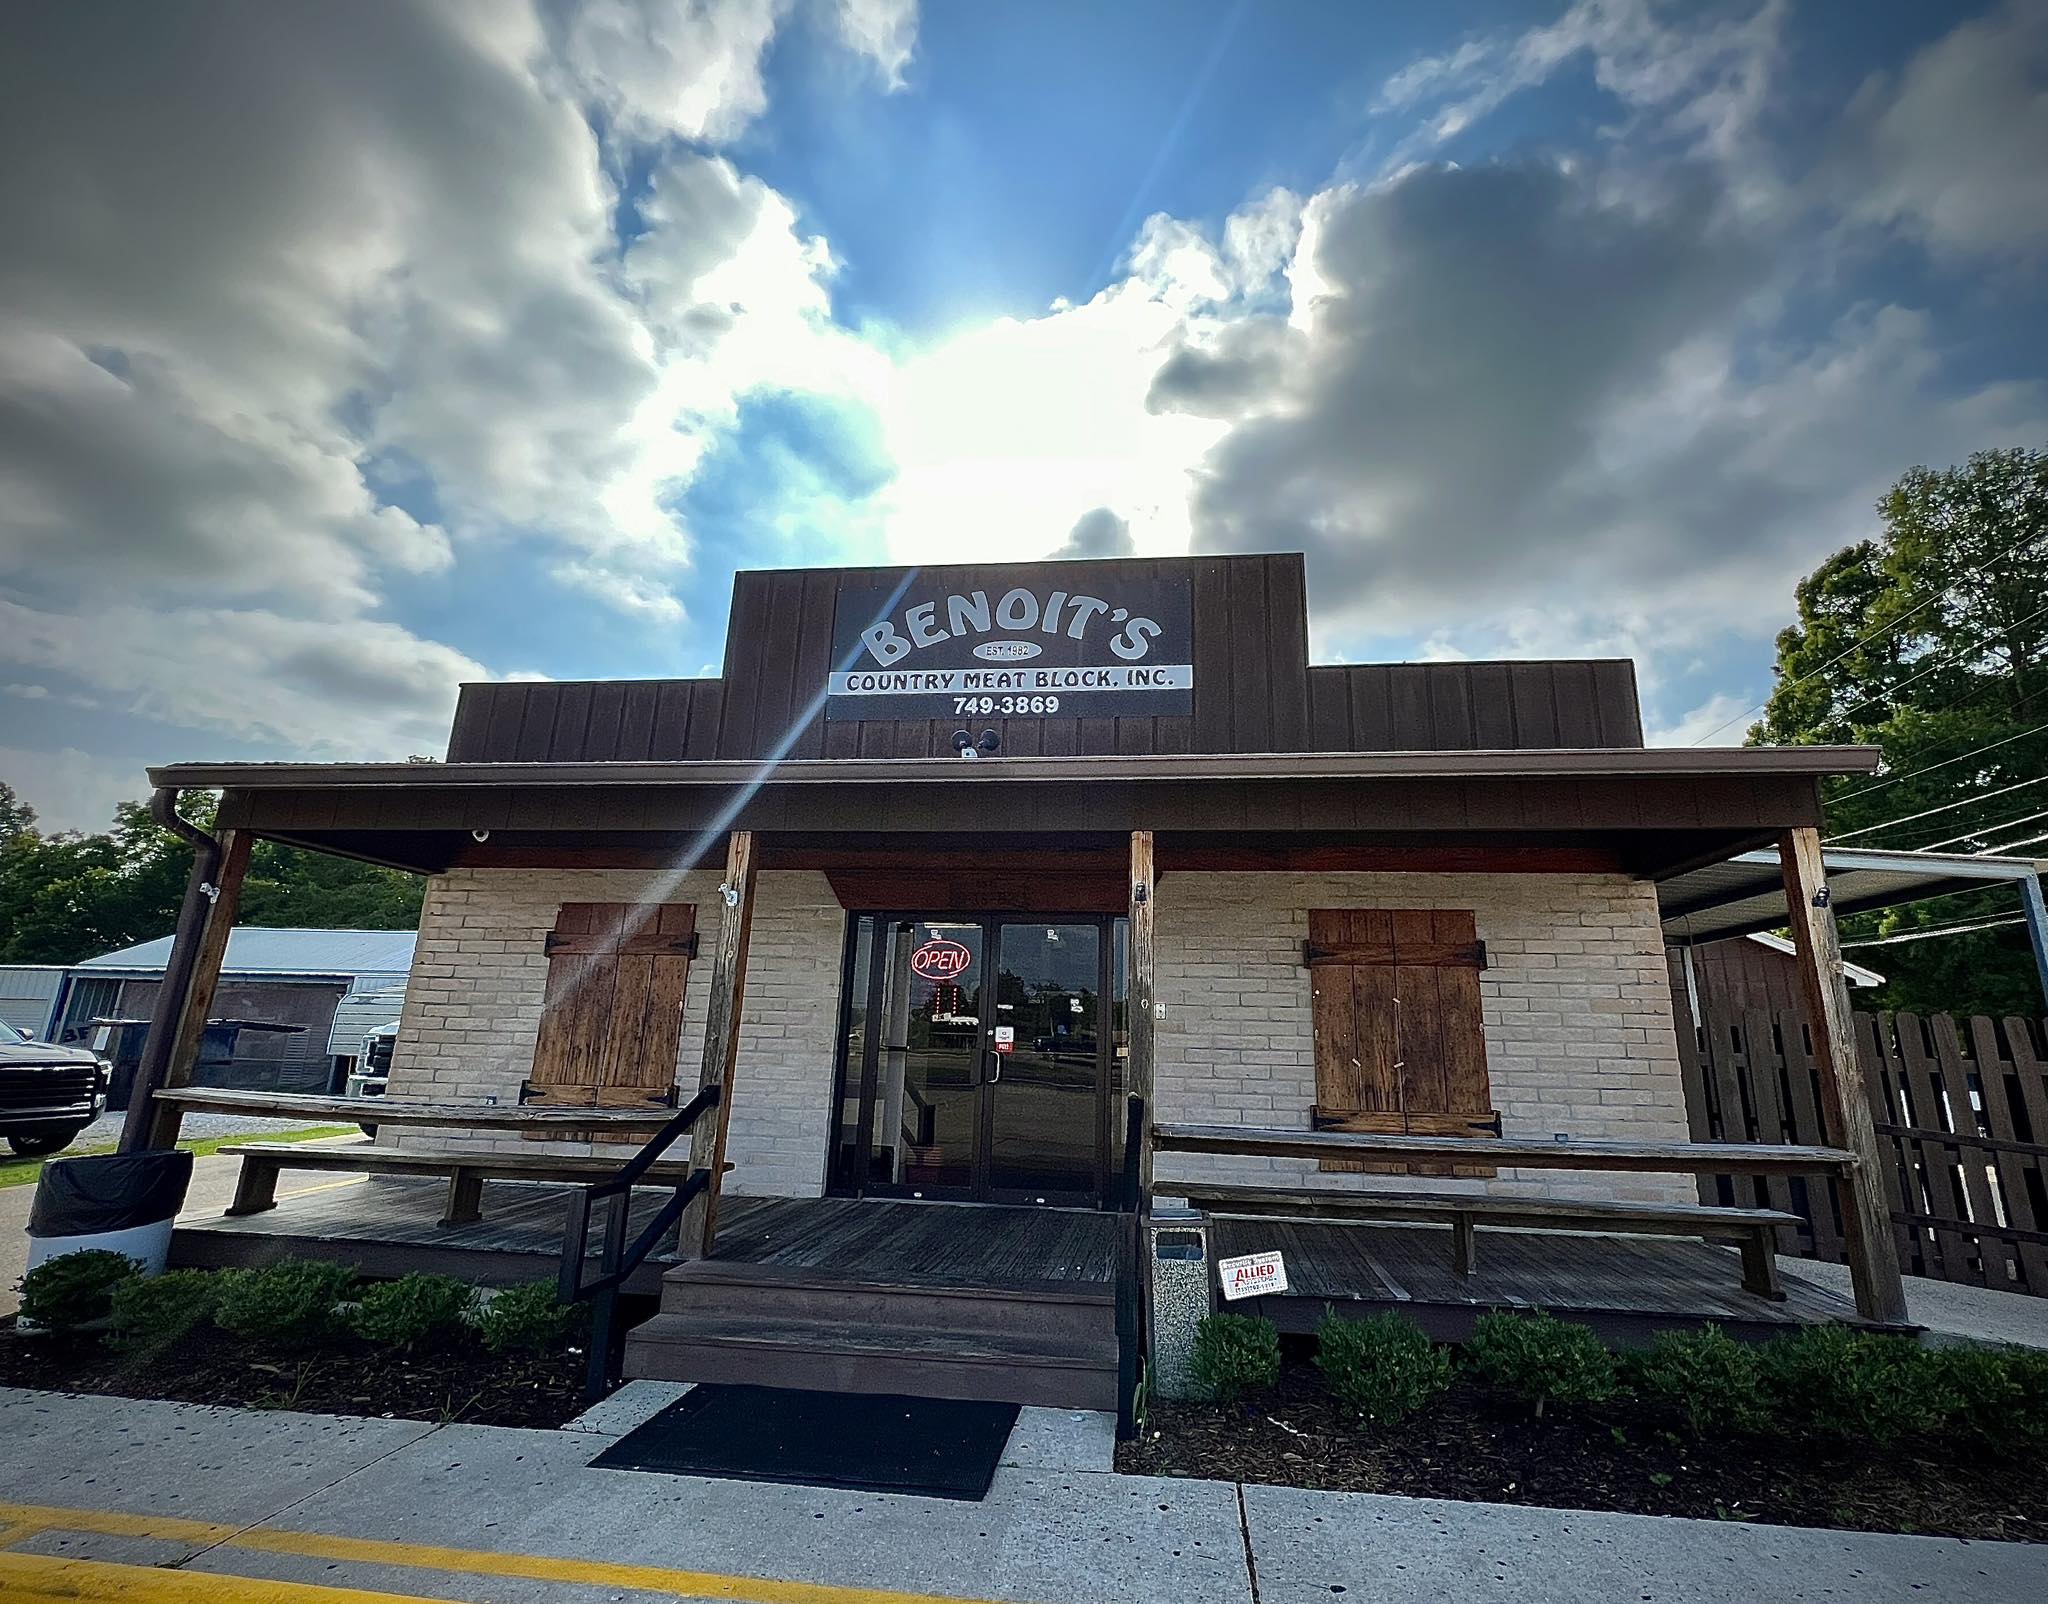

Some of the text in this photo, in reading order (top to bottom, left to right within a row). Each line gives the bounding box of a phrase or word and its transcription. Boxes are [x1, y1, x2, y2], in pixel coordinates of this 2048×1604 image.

[860, 588, 1162, 667] BENOIT'S
[986, 645, 1029, 656] EST. 1982
[846, 673, 955, 691] COUNTRY
[963, 671, 1027, 688] MEAT
[1127, 669, 1175, 686] INC.
[953, 695, 1060, 714] 749-3869
[914, 950, 965, 970] OPEN
[1236, 1264, 1275, 1285] ALLIED
